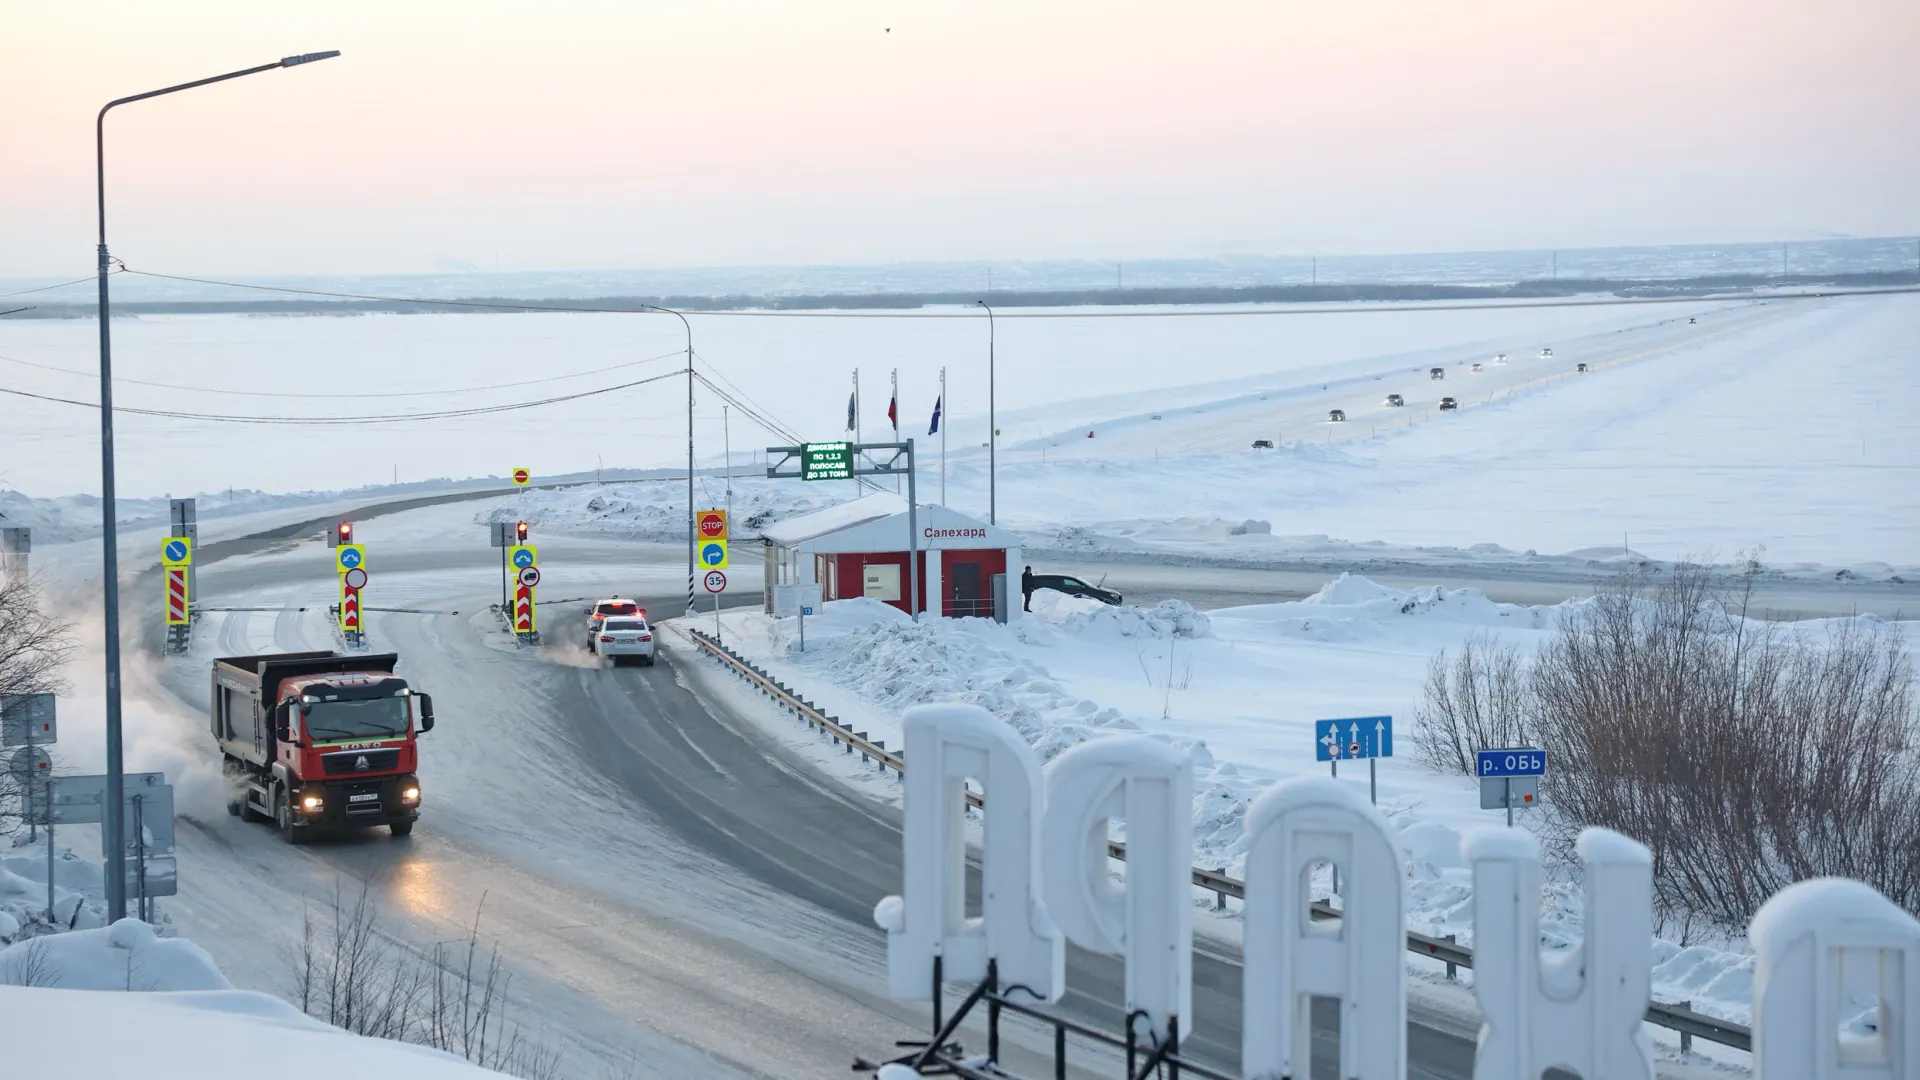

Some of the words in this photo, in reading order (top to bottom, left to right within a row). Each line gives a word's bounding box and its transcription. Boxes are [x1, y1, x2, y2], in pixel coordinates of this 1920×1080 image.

[807, 444, 846, 452] ДВИЖЕНИЕ
[809, 462, 845, 470] ПОЛОСАМ
[703, 521, 722, 530] STOP
[924, 528, 986, 538] Салехард
[340, 742, 381, 750] HOWO
[1483, 759, 1498, 775] р.
[1505, 755, 1541, 770] ОБЬ
